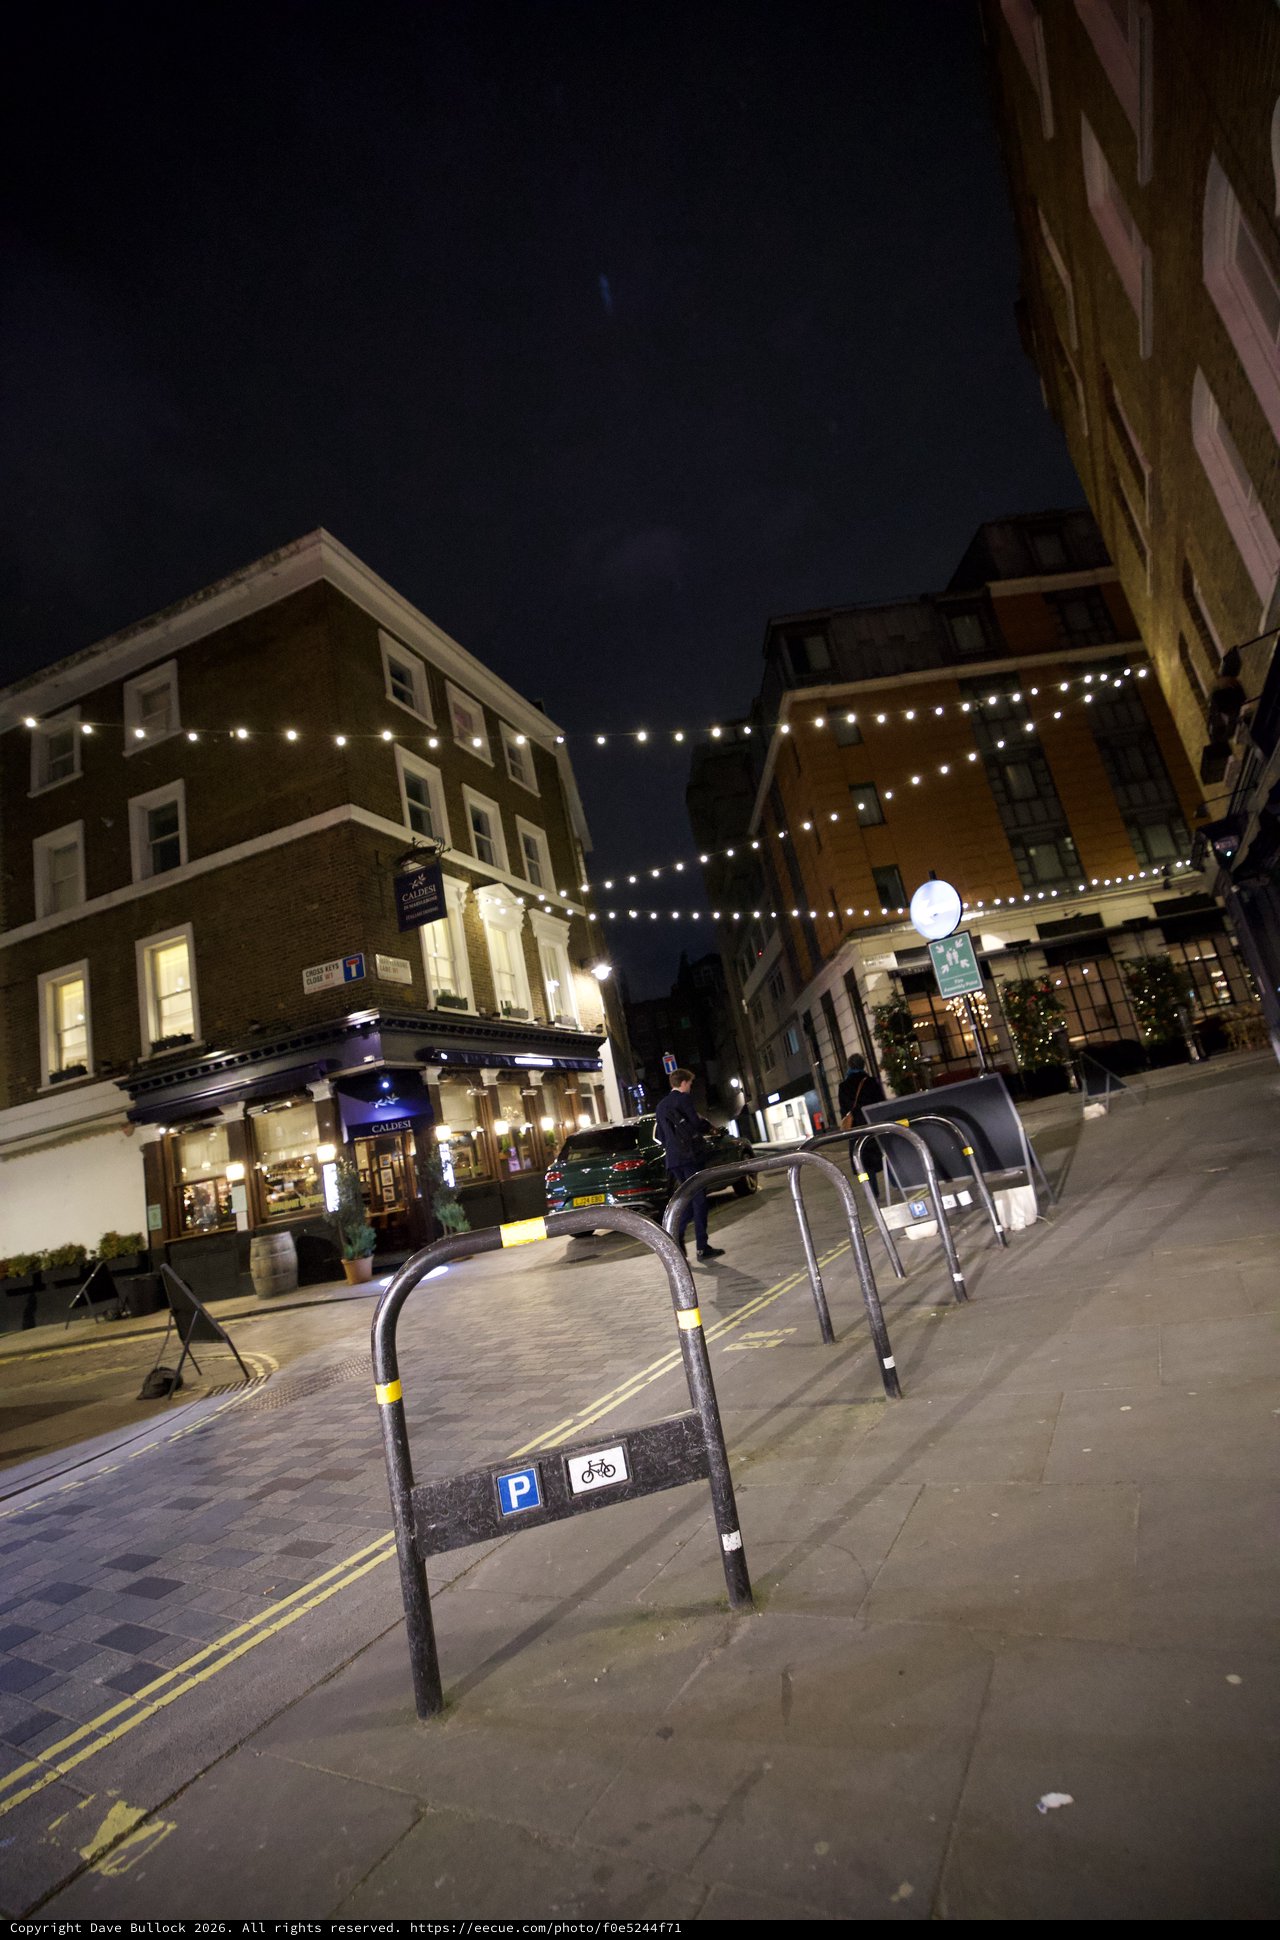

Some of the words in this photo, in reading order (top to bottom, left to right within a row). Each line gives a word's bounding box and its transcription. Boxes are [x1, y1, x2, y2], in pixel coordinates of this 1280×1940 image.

[402, 884, 436, 902] CALDESI
[305, 967, 324, 979] CROSS
[325, 963, 339, 973] KEYS
[306, 975, 324, 986] CLOSE
[324, 972, 334, 980] W1
[371, 1120, 411, 1133] CALDESI
[914, 1204, 922, 1215] P
[508, 1476, 531, 1509] P
